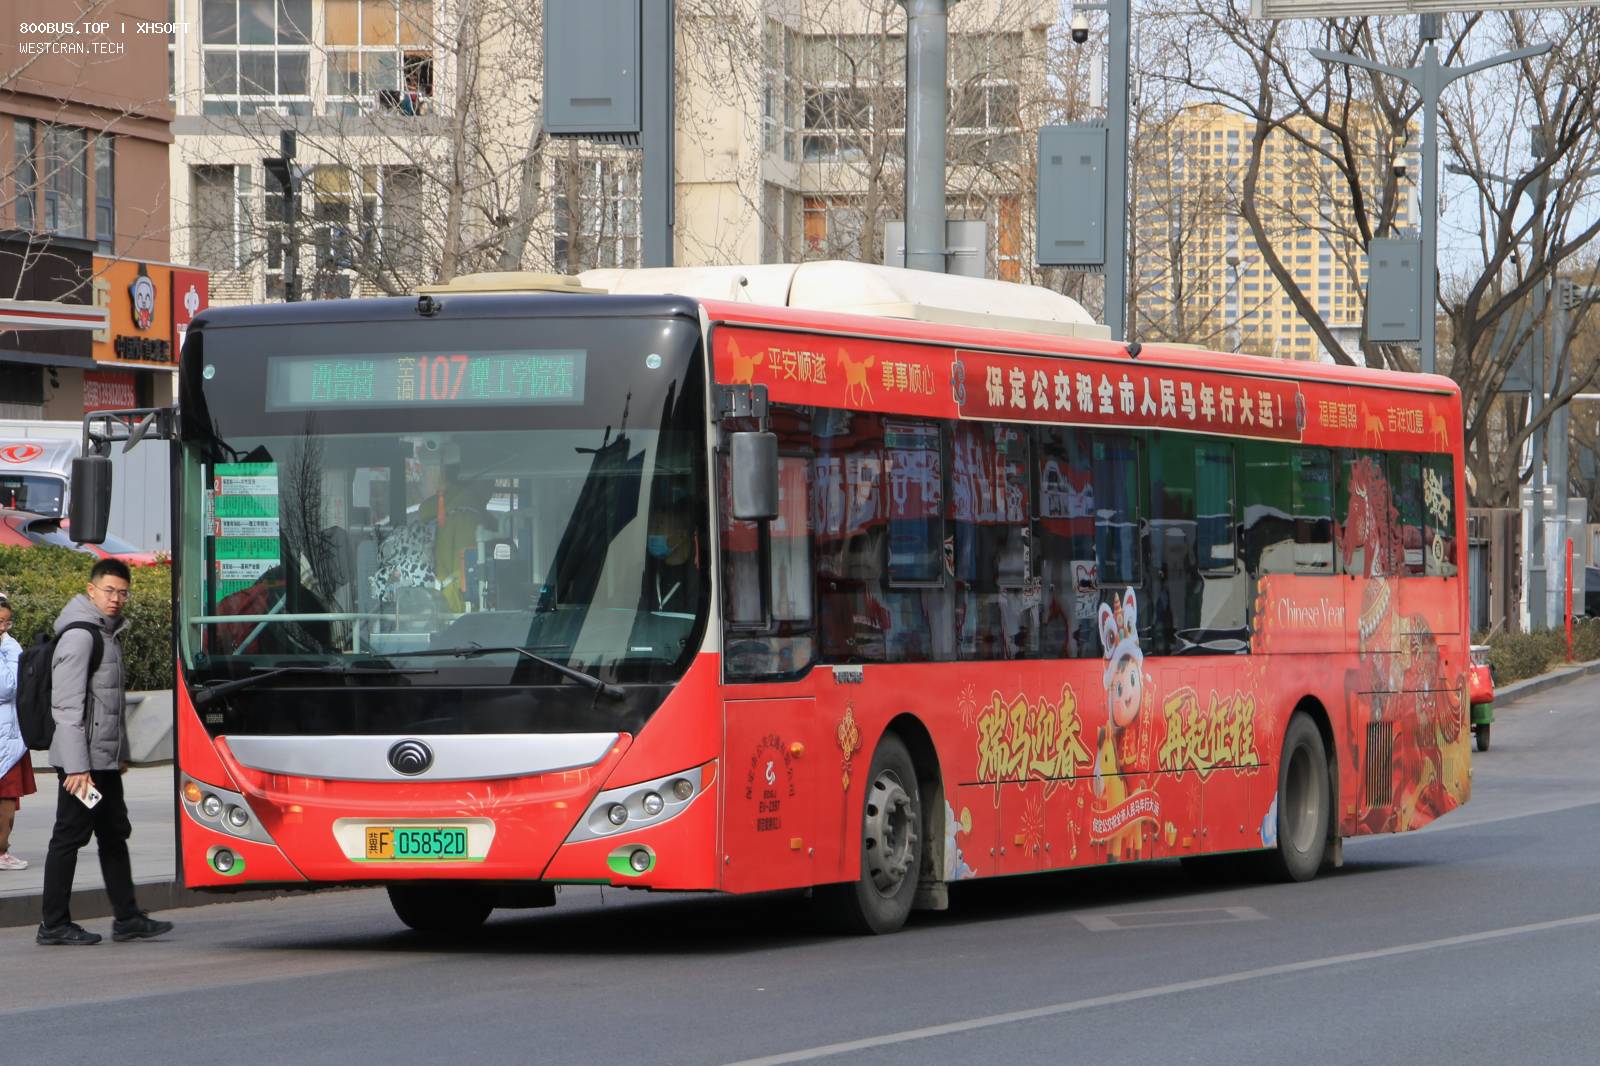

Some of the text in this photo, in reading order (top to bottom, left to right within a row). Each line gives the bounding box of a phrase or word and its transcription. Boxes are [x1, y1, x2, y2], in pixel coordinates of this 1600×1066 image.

[418, 354, 468, 401] 107
[768, 347, 827, 385] 平安顺遂
[881, 360, 936, 395] 事事顺心
[1318, 400, 1358, 430] 福星高照
[1387, 406, 1425, 435] 吉祥如意
[1278, 598, 1344, 628] Chinese Year
[977, 685, 1092, 806] 瑞马迎春
[1159, 686, 1260, 779] 再起征程
[399, 831, 465, 855] 05852D
